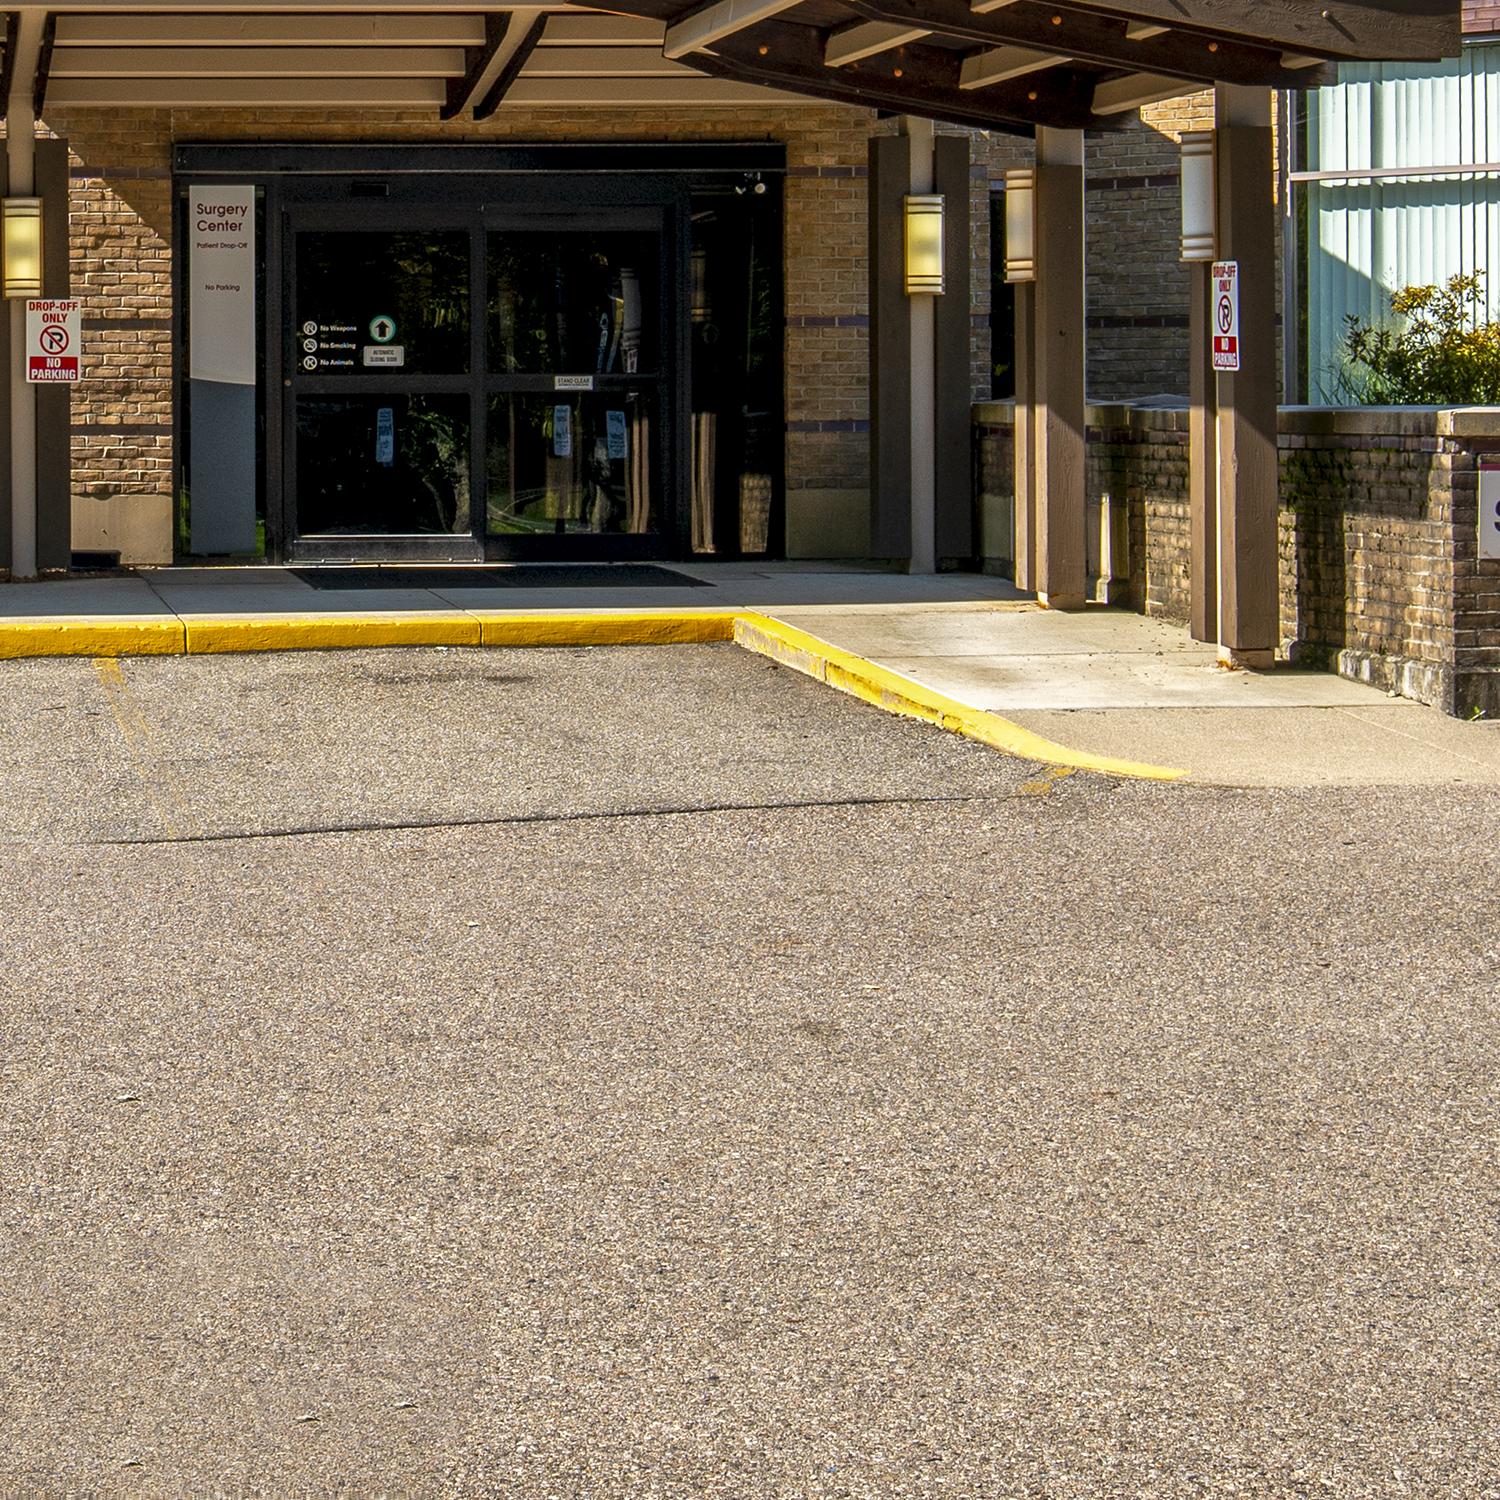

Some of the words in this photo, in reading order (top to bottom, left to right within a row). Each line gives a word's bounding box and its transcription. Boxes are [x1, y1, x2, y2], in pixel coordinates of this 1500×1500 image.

[196, 203, 248, 218] Surgery
[196, 220, 243, 232] Center
[220, 242, 248, 250] Drop-Off
[216, 284, 240, 292] Parking
[29, 301, 78, 311] DROP-OFF
[42, 313, 68, 323] ONLY
[330, 342, 356, 350] Smoking
[46, 357, 61, 368] NO
[31, 369, 76, 380] PARKING
